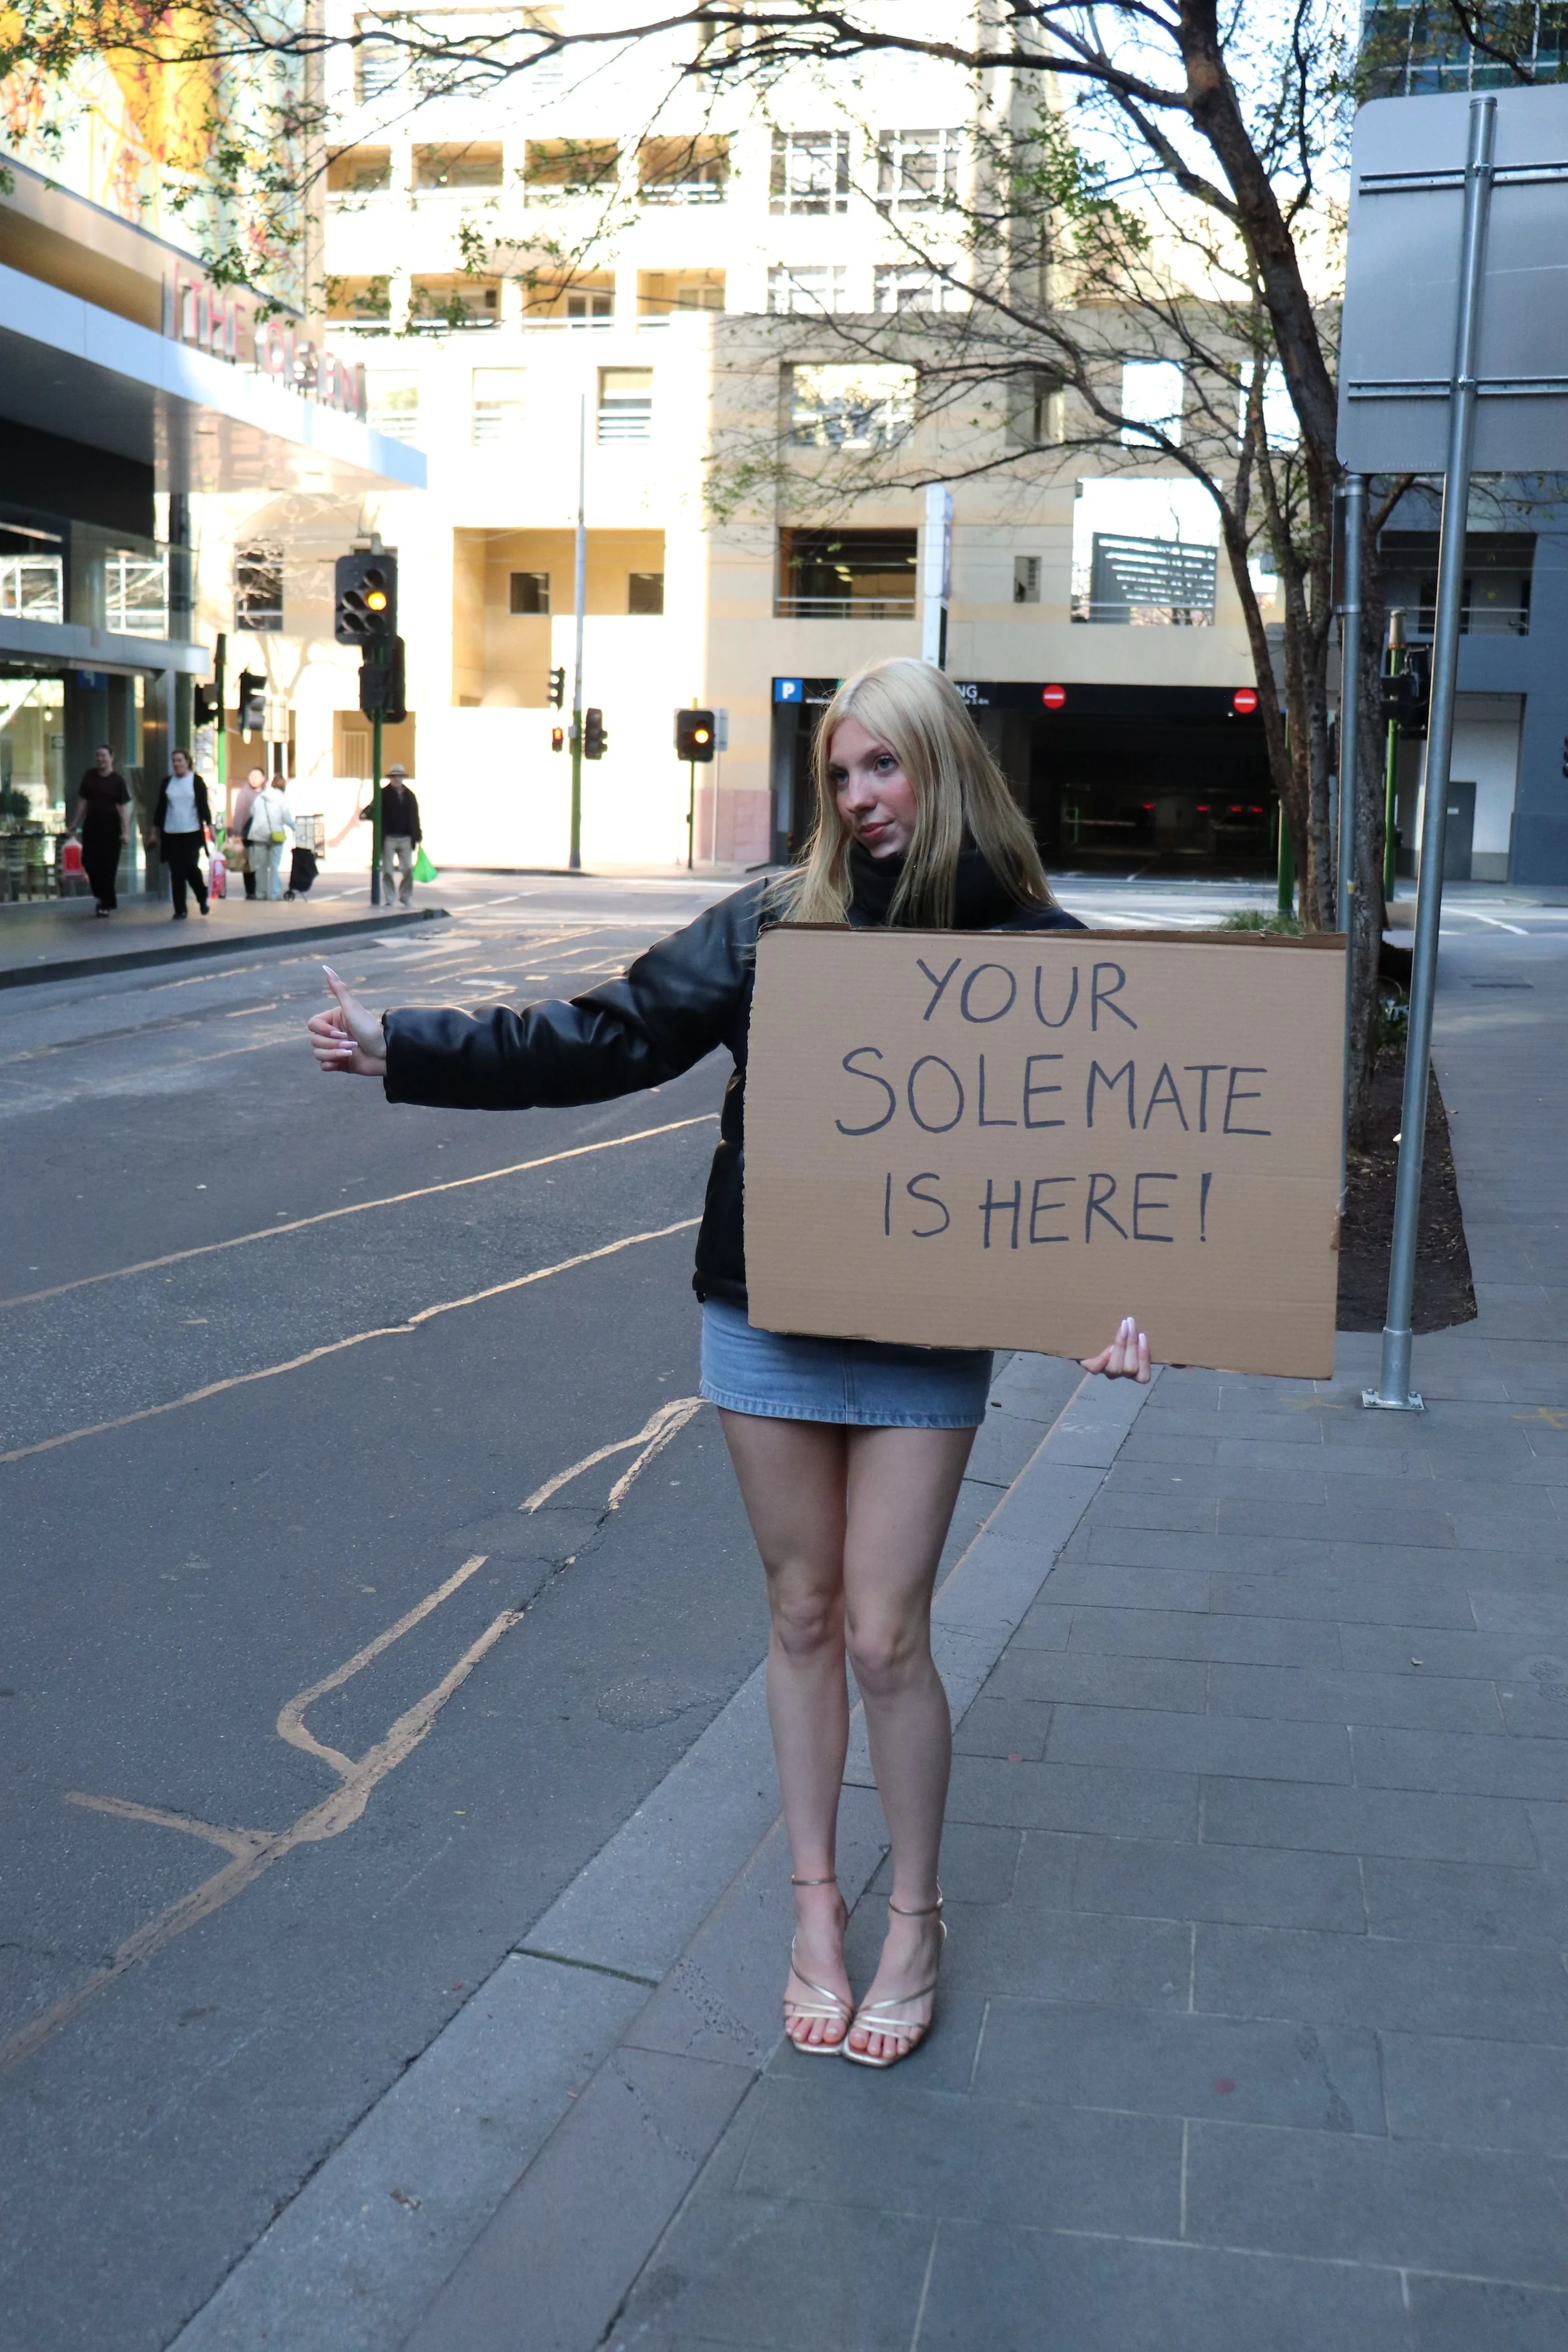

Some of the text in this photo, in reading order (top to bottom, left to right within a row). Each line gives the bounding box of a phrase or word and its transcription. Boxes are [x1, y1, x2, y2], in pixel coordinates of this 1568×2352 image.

[184, 280, 245, 358] THE
[781, 681, 796, 699] P
[916, 957, 1138, 1032] YOUR
[834, 1046, 1272, 1136] SOLEMATE
[884, 1172, 1212, 1250] IS HERE!
